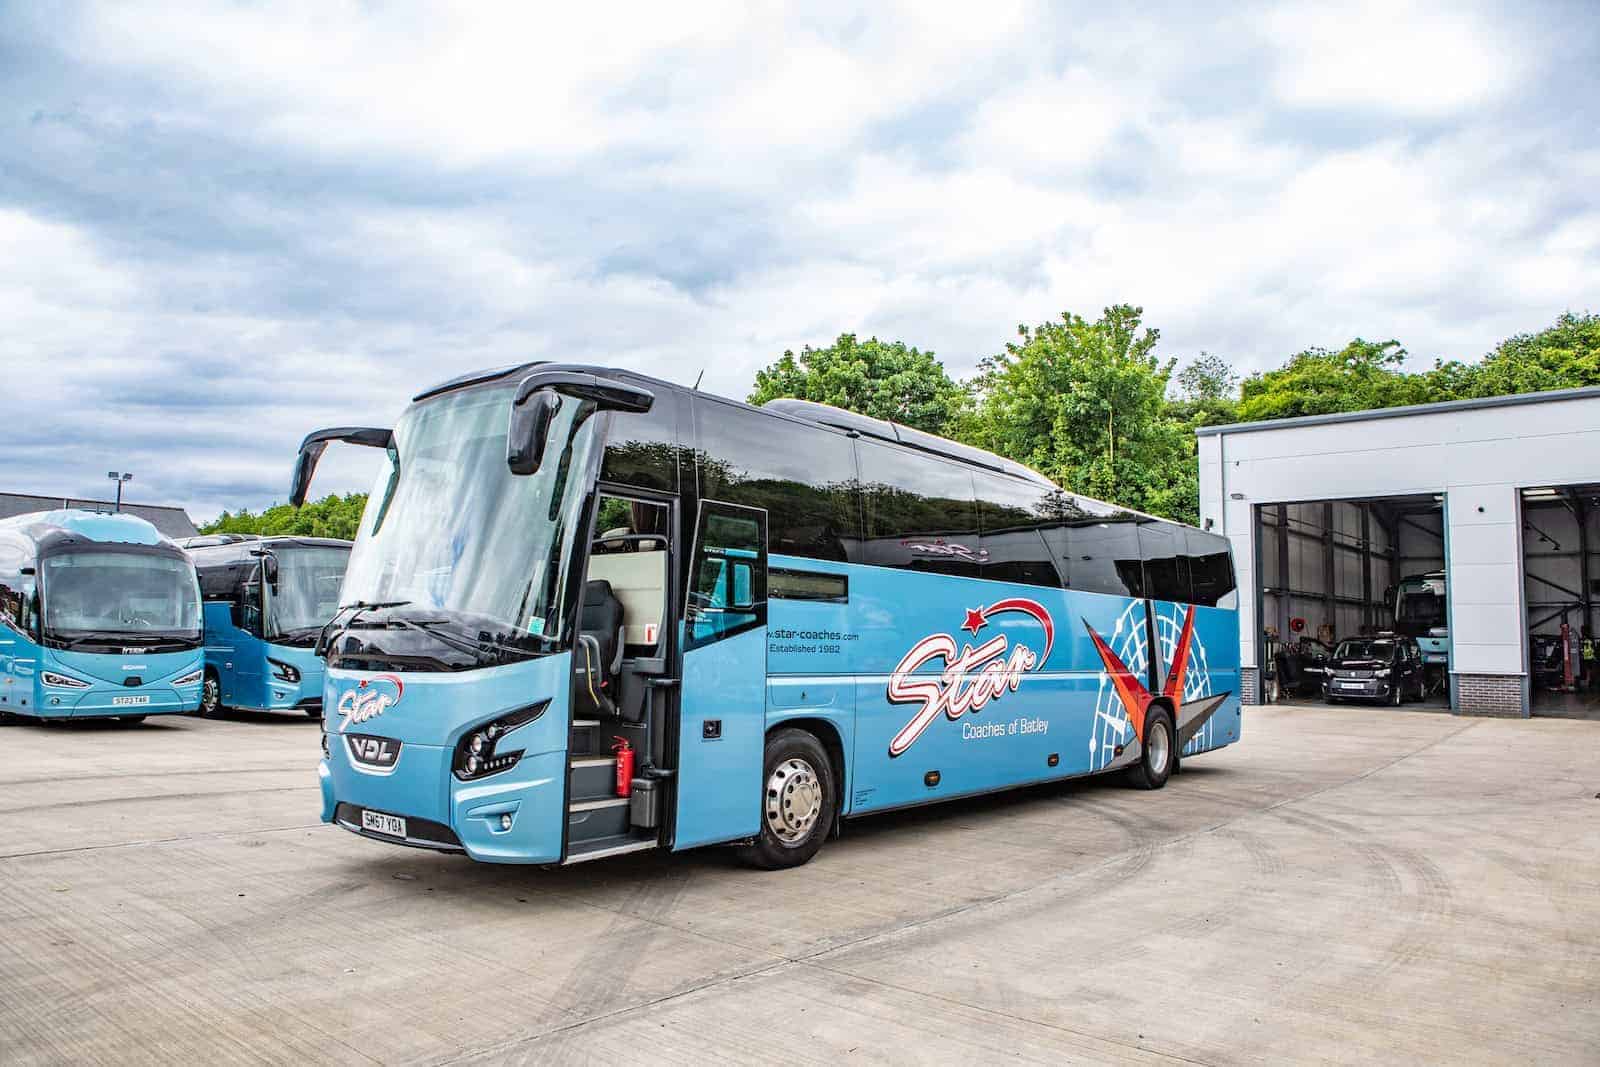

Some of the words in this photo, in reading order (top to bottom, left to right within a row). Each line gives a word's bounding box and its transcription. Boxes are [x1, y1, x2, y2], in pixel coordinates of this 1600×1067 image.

[769, 643, 817, 653] Established
[819, 645, 840, 654] 1982
[888, 633, 1036, 757] Star
[338, 689, 393, 734] Star
[962, 721, 1006, 740] Coaches
[1008, 719, 1018, 735] of
[1020, 717, 1049, 735] Batley
[352, 738, 393, 760] VDL
